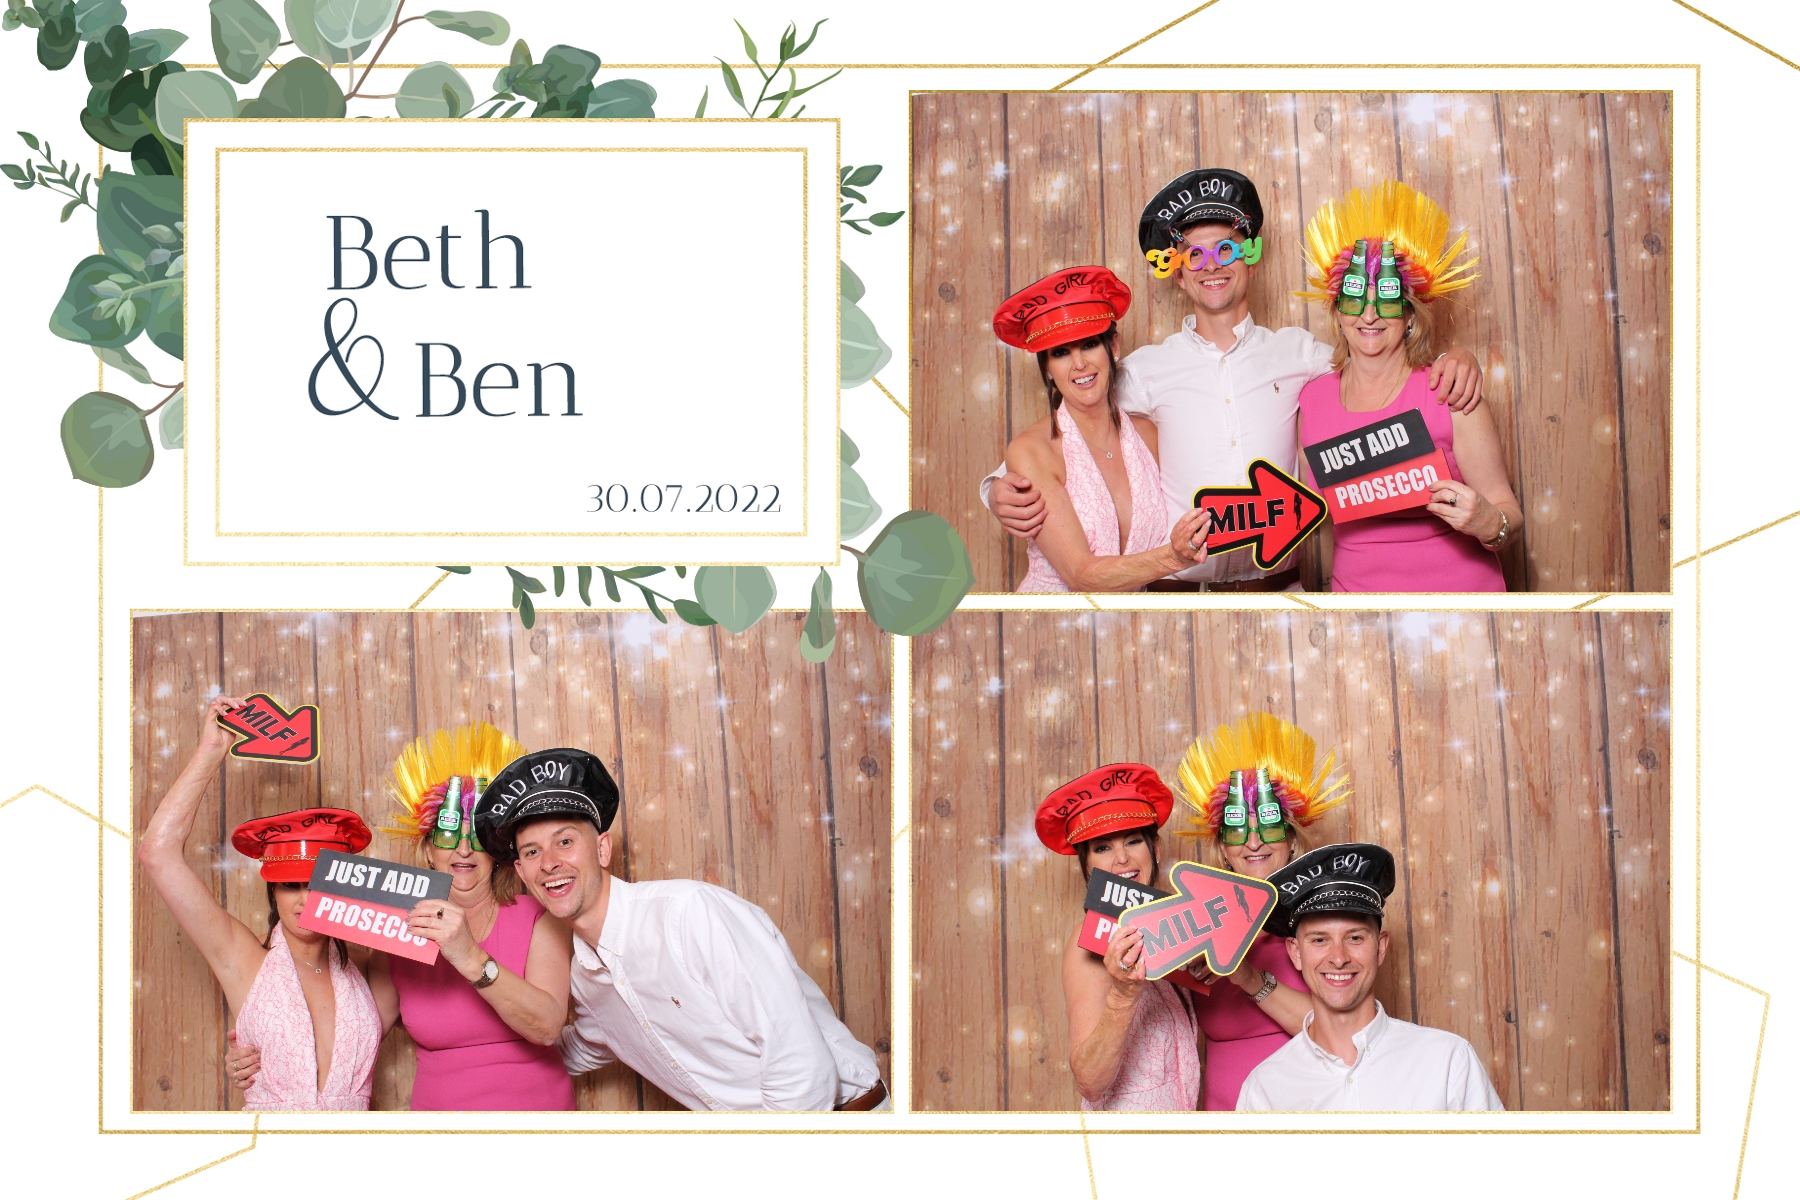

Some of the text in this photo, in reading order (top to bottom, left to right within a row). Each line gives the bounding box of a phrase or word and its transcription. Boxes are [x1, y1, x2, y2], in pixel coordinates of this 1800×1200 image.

[1158, 178, 1232, 221] BAD BOY
[1054, 273, 1091, 295] GIRL
[1319, 423, 1410, 474] JUST ADD
[1335, 464, 1439, 509] PROSECCO
[1206, 498, 1284, 535] MILF
[234, 703, 298, 741] MILF
[491, 760, 571, 816] BAD BOY
[325, 860, 431, 898] JUST ADD
[1280, 853, 1370, 895] BAD BOY
[1138, 895, 1229, 957] MILF
